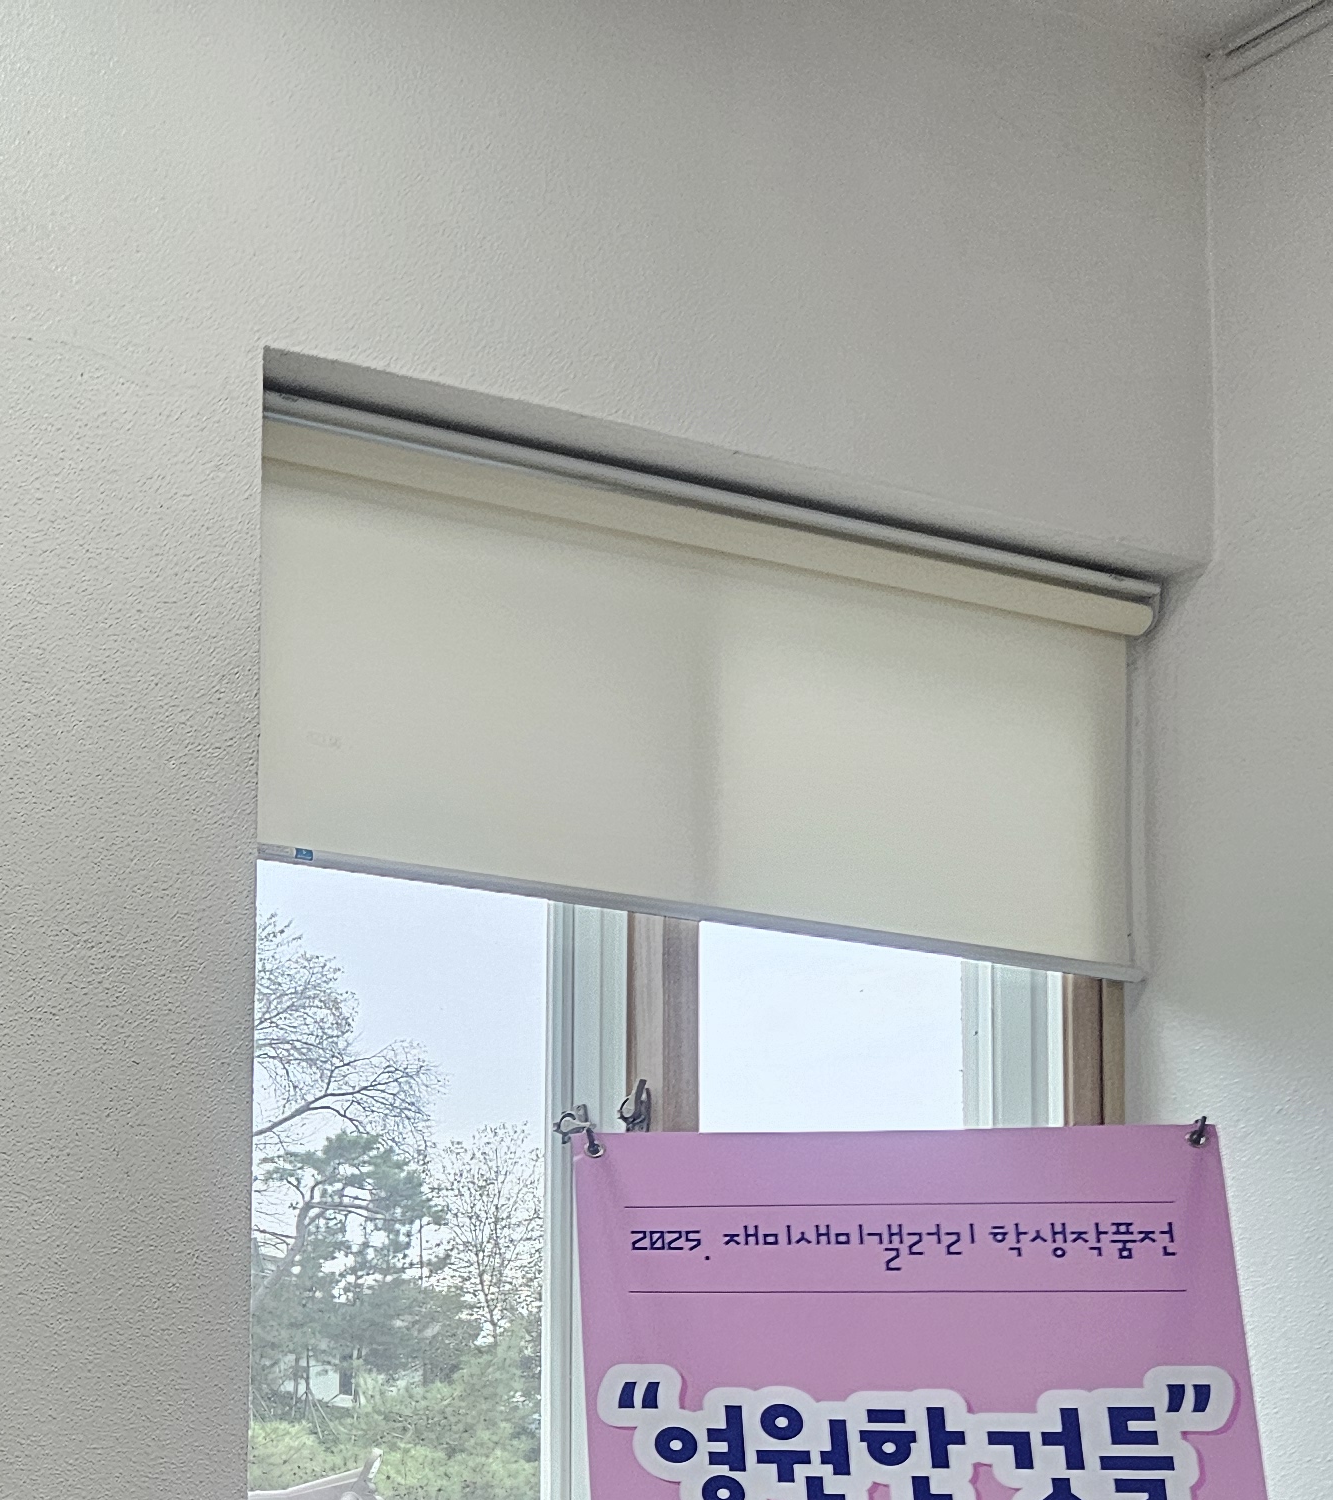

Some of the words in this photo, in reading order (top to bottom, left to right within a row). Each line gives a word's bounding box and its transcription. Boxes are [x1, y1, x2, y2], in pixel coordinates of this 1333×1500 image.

[630, 1229, 711, 1261] 2025.
[722, 1222, 976, 1271] 재미새미갤러리
[988, 1221, 1177, 1260] 학생작품전
